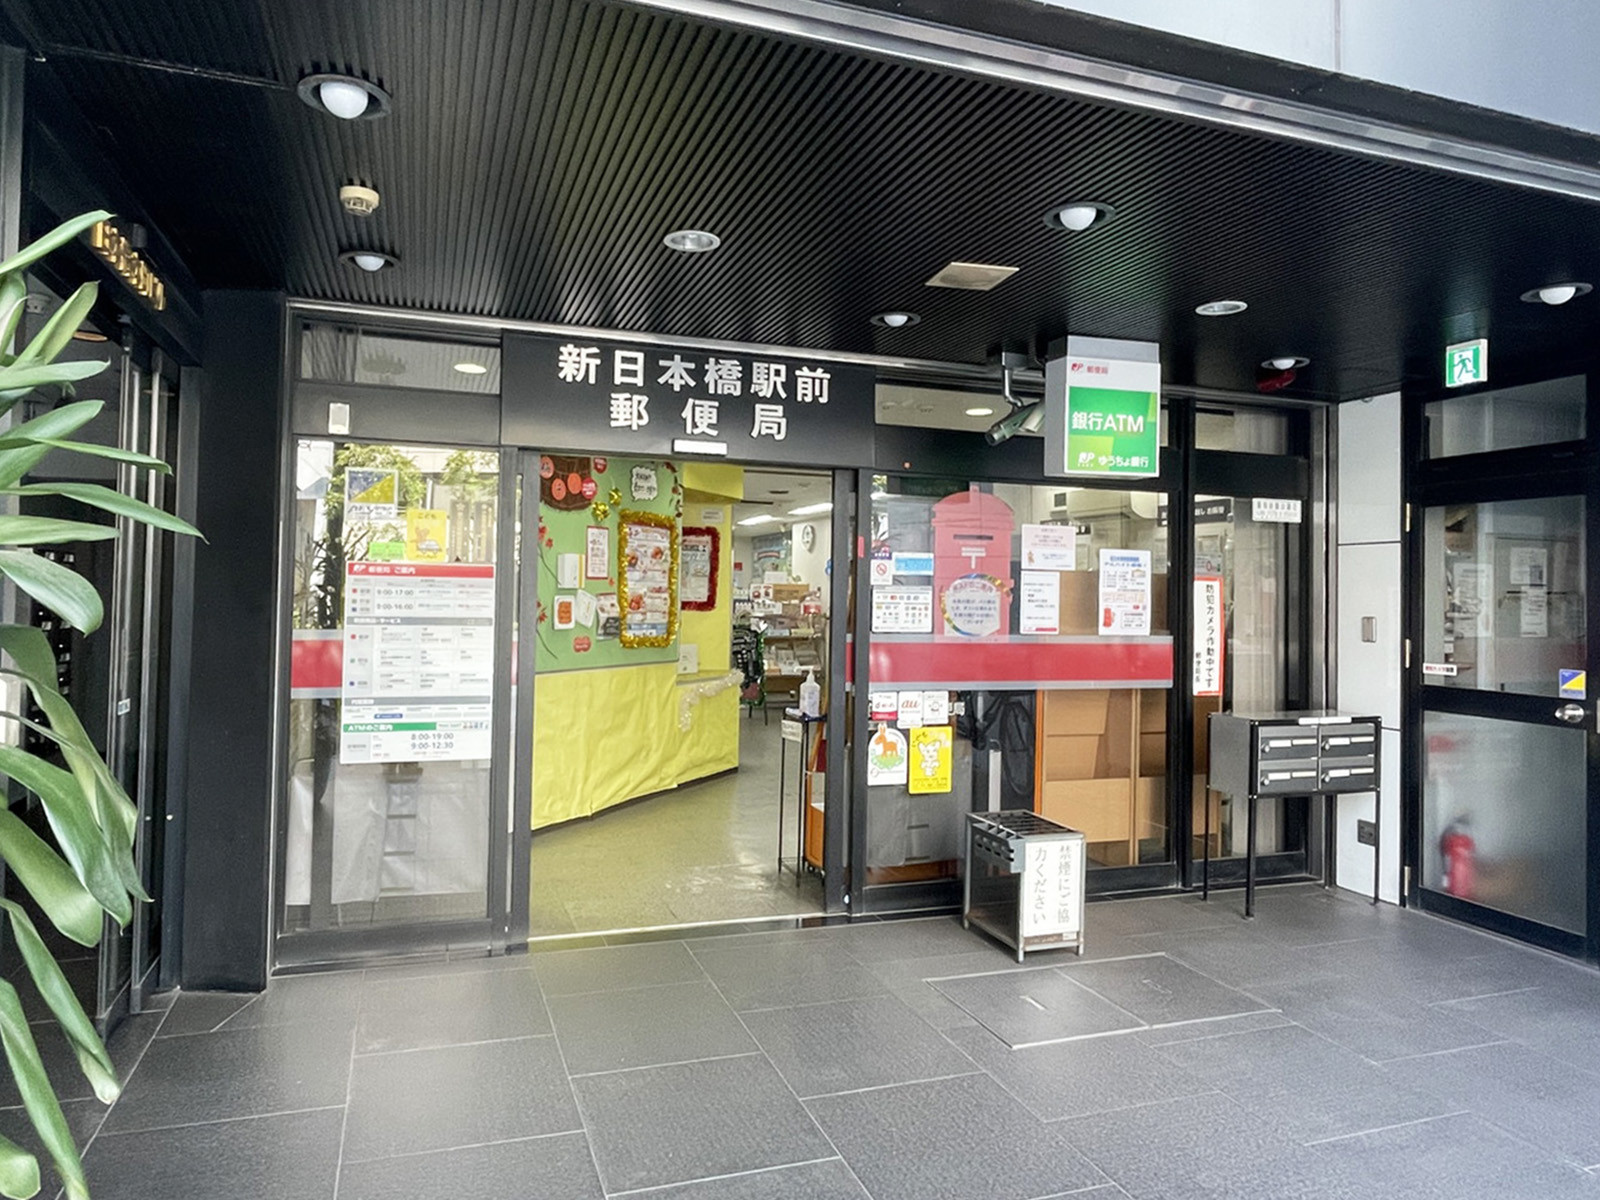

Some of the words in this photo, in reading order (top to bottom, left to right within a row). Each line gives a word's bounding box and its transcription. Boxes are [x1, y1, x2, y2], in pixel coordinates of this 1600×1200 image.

[558, 344, 831, 404] 新日本橋駅前
[609, 393, 788, 440] 郵便局
[1071, 411, 1144, 432] 銀行ATM
[1098, 456, 1149, 468] ゆうちょ銀行
[1205, 584, 1216, 688] 防犯カメラ作動中です
[901, 700, 921, 709] au
[410, 733, 454, 741] 8:00-19:00
[410, 742, 454, 750] 9:00-12:30
